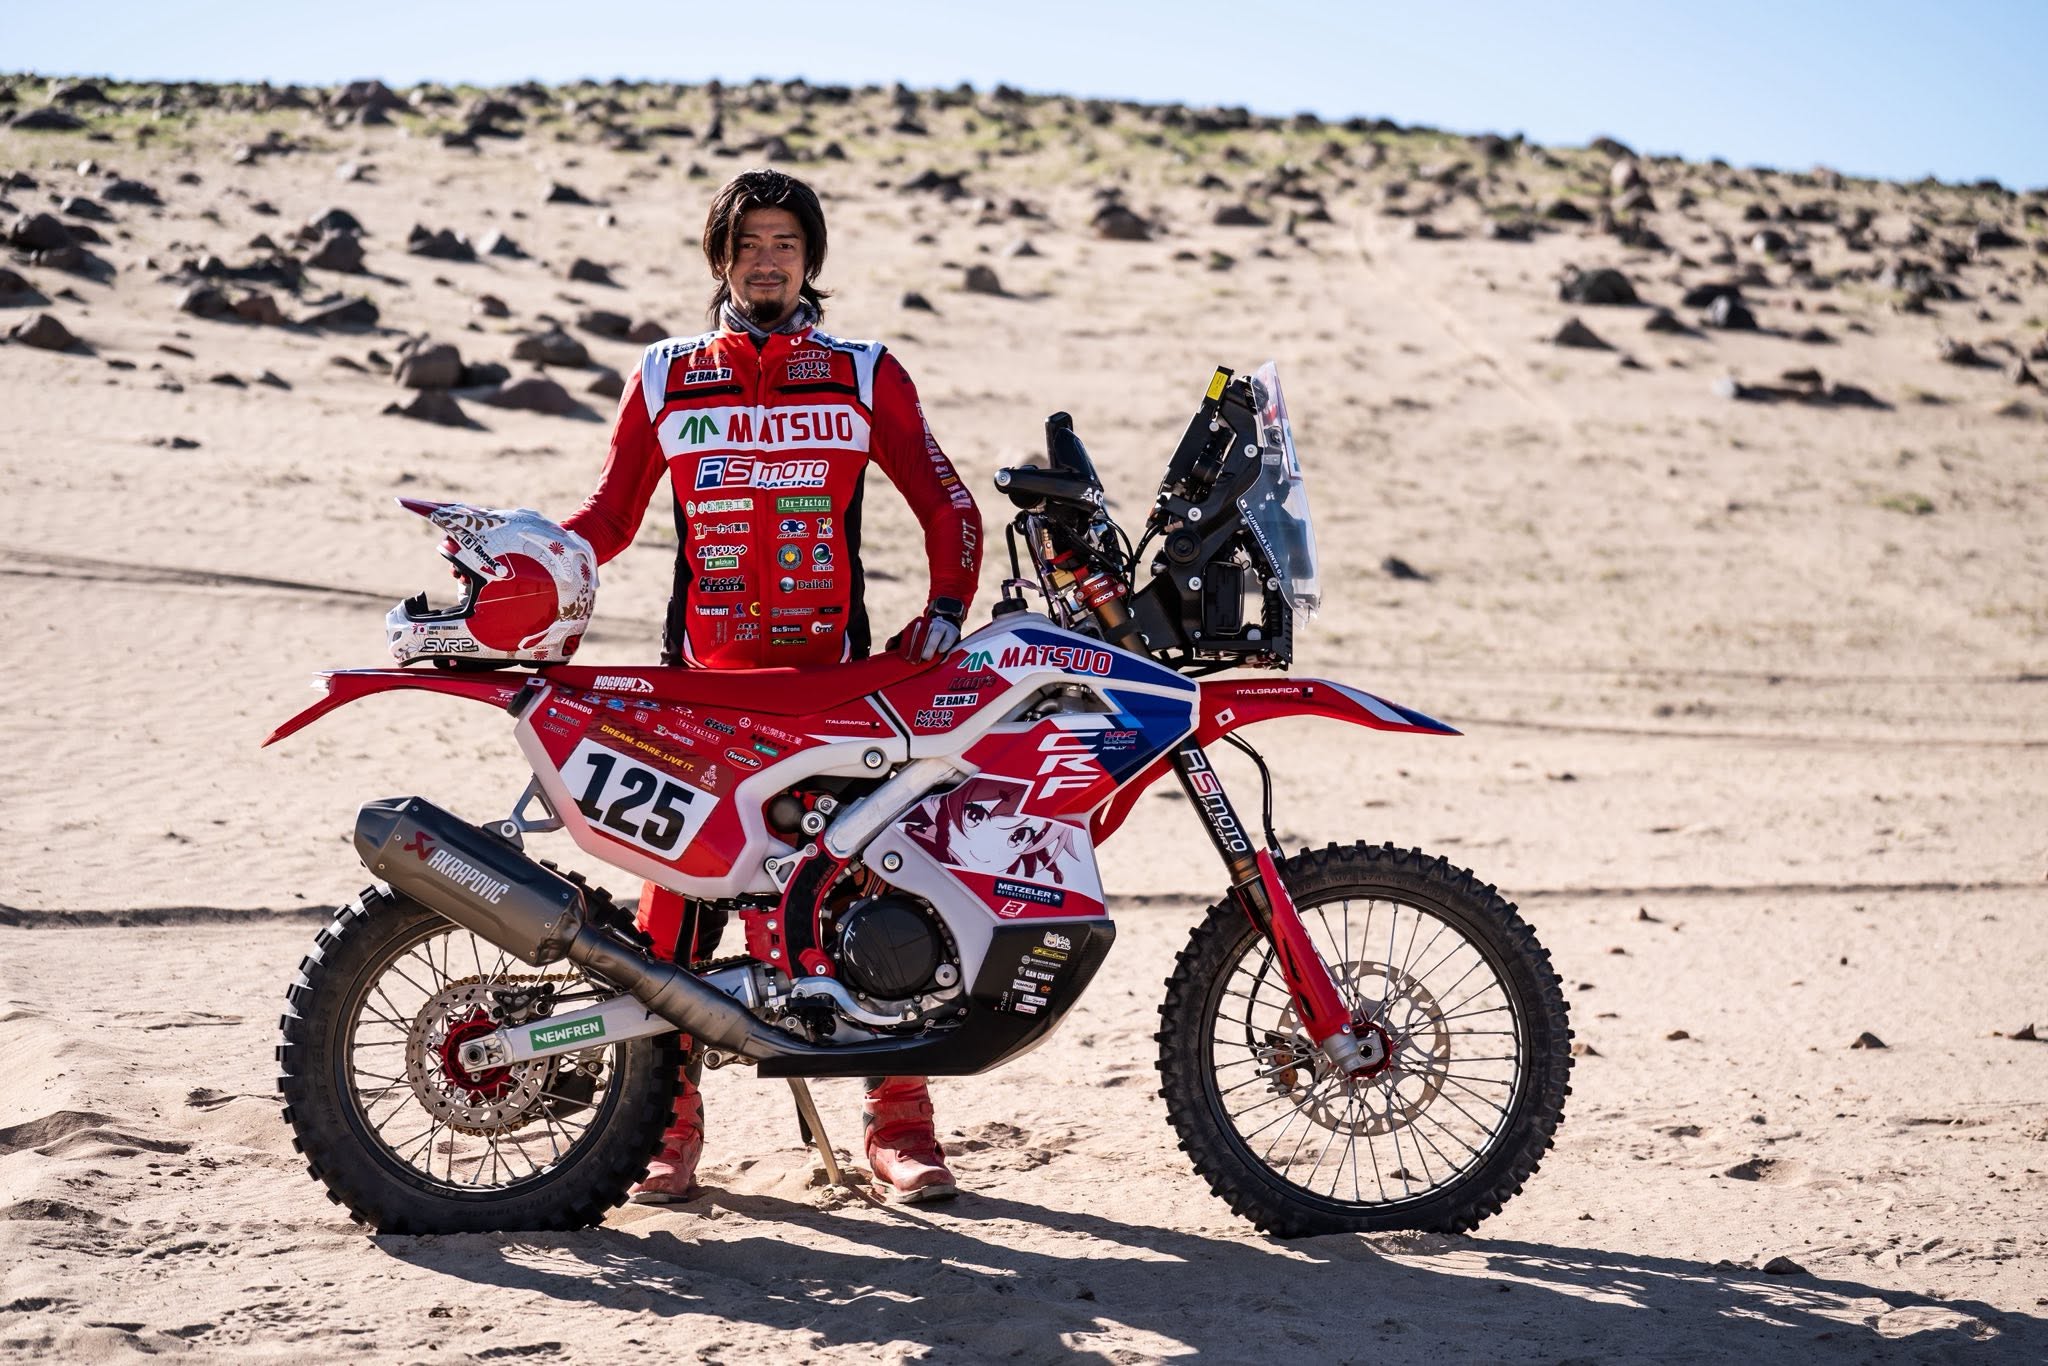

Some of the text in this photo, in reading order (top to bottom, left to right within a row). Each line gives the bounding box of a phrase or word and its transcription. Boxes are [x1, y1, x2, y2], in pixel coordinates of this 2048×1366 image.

[727, 412, 852, 444] MATSUO
[757, 480, 822, 488] RACING
[1245, 510, 1268, 545] FUJIWARA
[1263, 544, 1281, 569] SHINYA
[424, 638, 474, 652] SMRP
[997, 645, 1113, 675] MATSUO
[594, 675, 638, 688] NOGUCHI
[1236, 687, 1300, 695] ITALGRAFICA
[560, 697, 593, 715] ZANARDO
[945, 694, 977, 706] BAN-ZI
[913, 718, 952, 727] MAX
[914, 710, 955, 719] MUD
[600, 724, 694, 772] DREAM. DARE. LIVE IT.
[727, 750, 748, 763] Twin
[746, 758, 760, 767] Air
[572, 752, 696, 852] 125
[1200, 797, 1234, 853] FACTORY
[427, 848, 509, 906] AKRAPOVIČ
[998, 883, 1052, 898] METZELER
[1025, 970, 1055, 982] GAN CRAFT
[534, 1021, 601, 1045] NEWFREN
